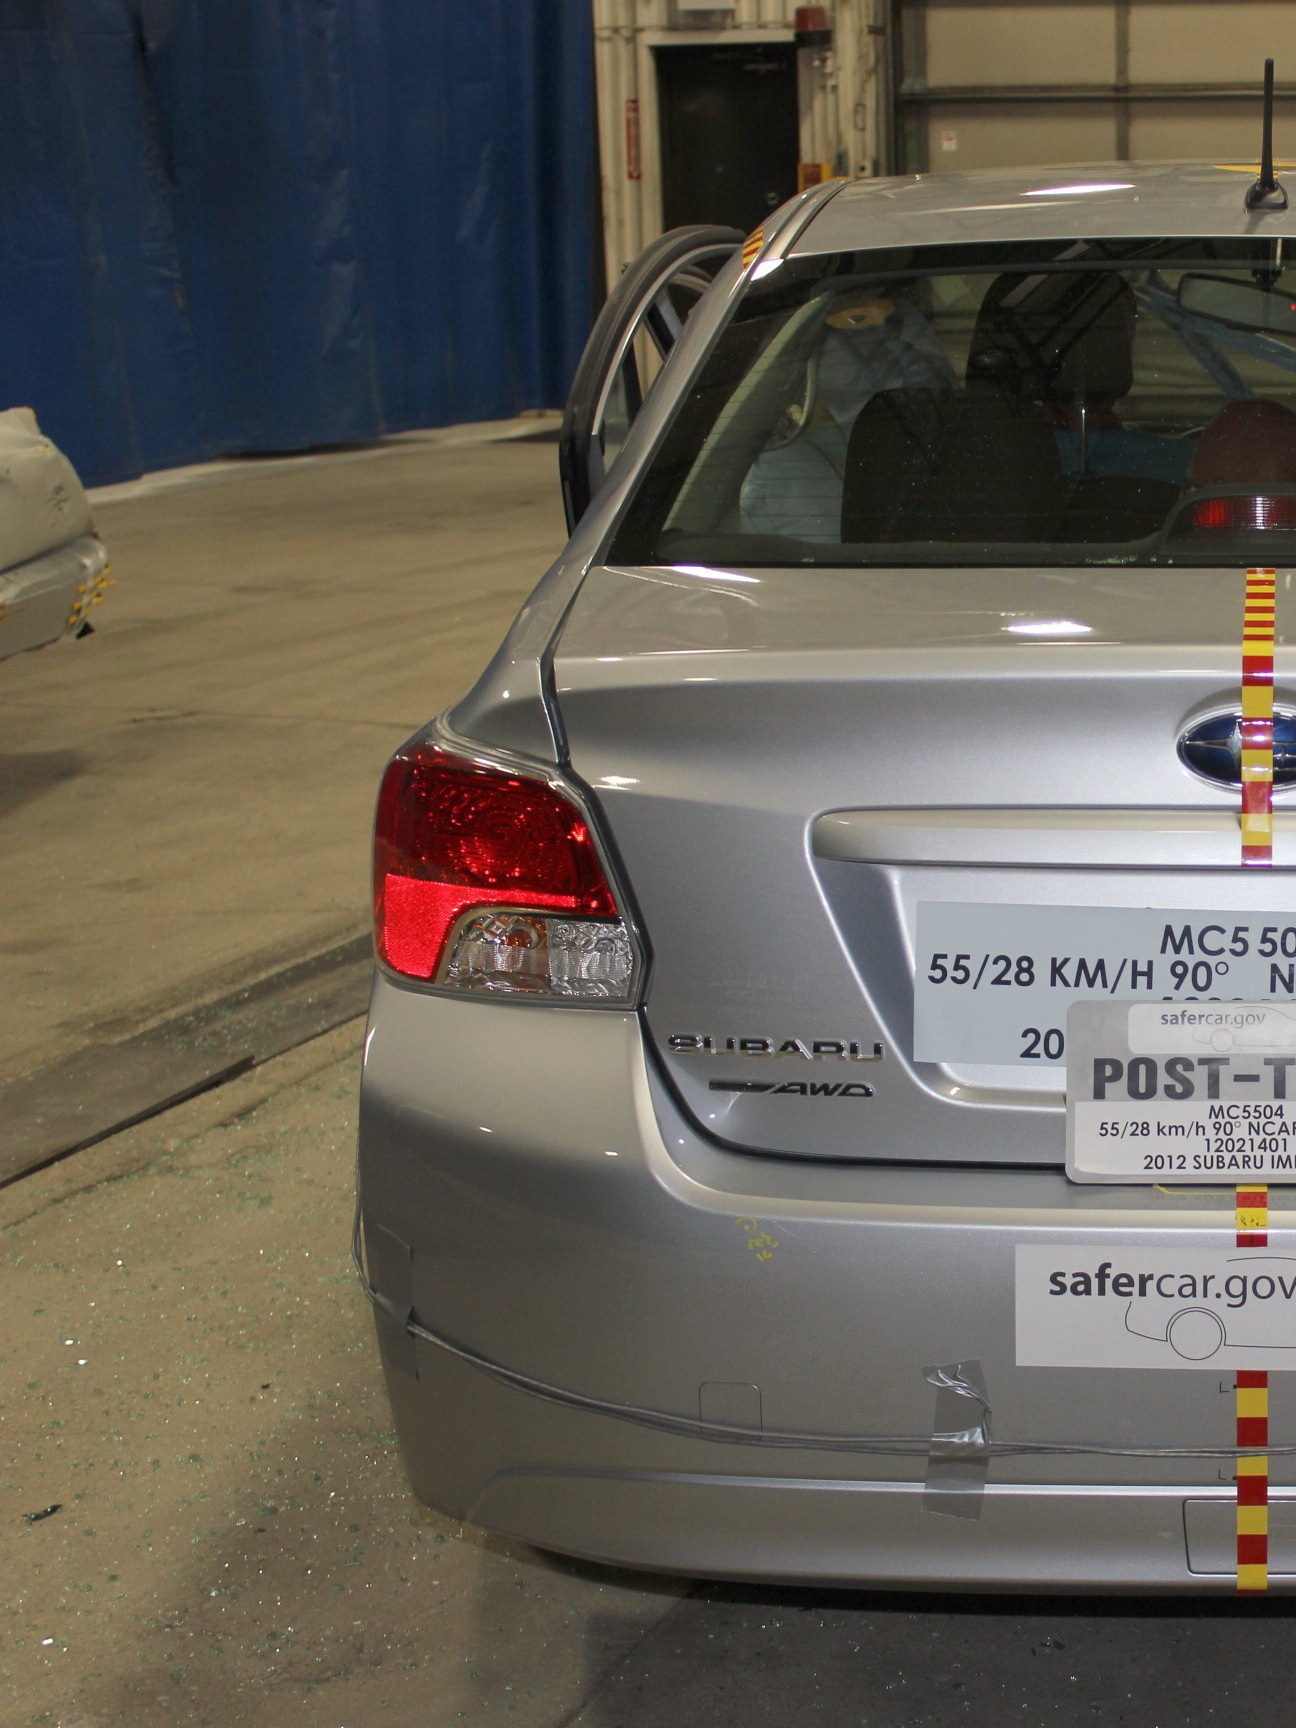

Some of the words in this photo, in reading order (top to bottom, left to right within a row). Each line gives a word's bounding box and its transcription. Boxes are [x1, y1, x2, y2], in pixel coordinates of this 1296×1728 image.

[927, 953, 1035, 990] 55/28
[1050, 956, 1154, 994] KM/H
[1169, 959, 1230, 993] 90°
[1160, 1009, 1267, 1029] safercar.gov
[668, 1033, 886, 1062] SUBARU
[768, 1081, 875, 1097] AWD
[1208, 1104, 1285, 1120] MC5504
[1099, 1121, 1151, 1139] 55/28
[1156, 1120, 1206, 1138] km/h
[1212, 1121, 1242, 1137] 90°
[1204, 1138, 1288, 1153] 12021401
[1143, 1154, 1187, 1170] 2012
[1193, 1154, 1264, 1170] SUBARU
